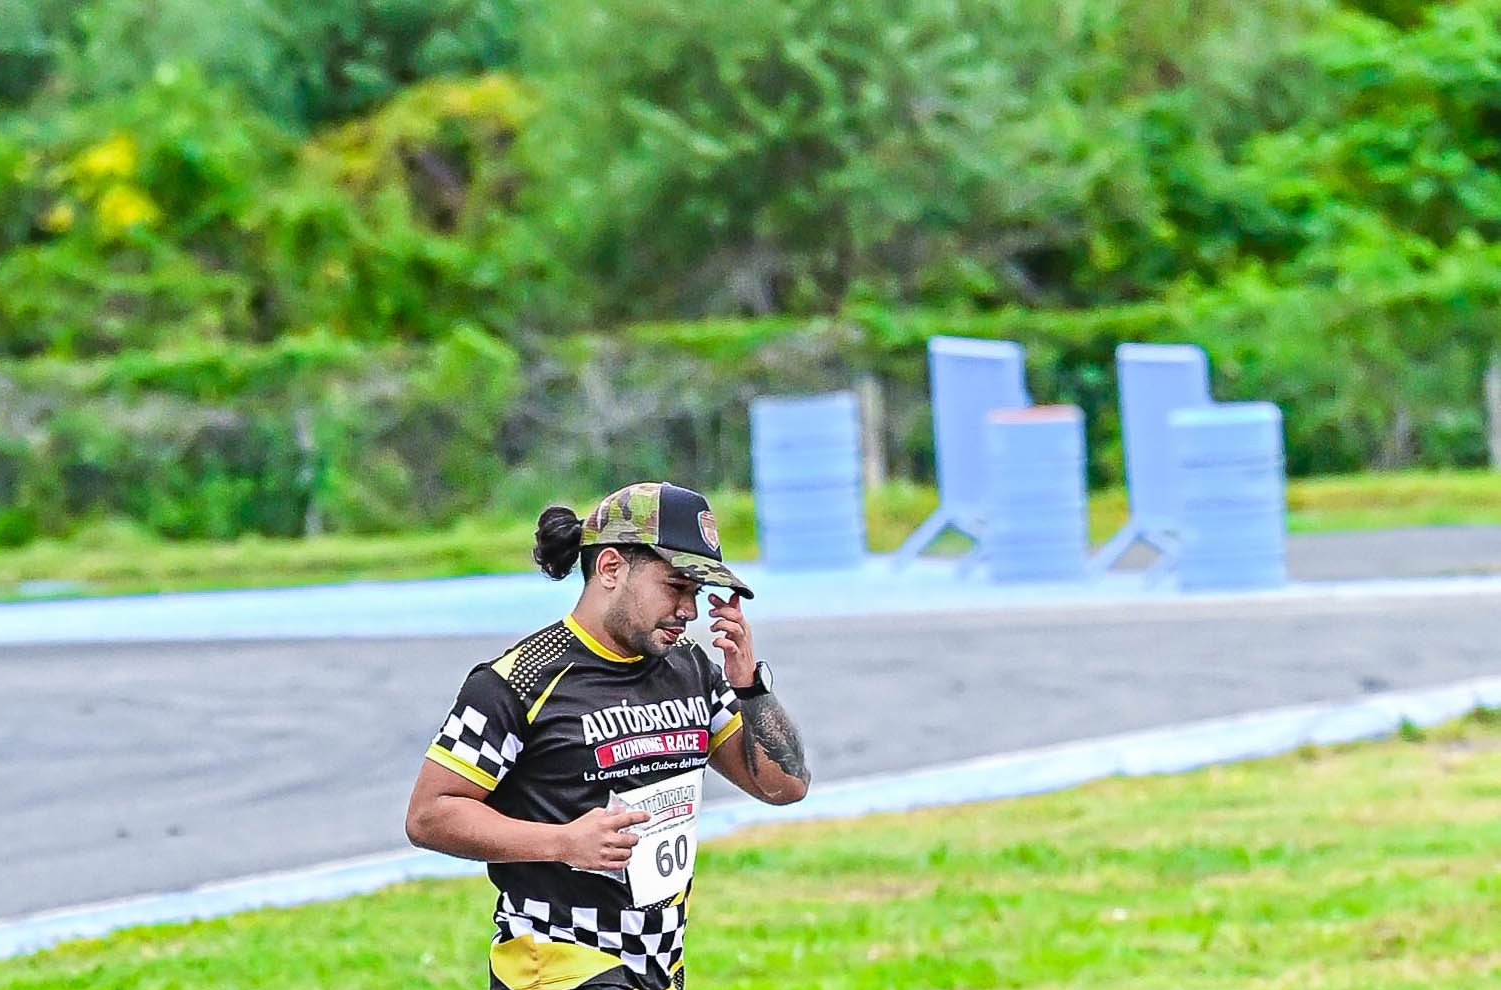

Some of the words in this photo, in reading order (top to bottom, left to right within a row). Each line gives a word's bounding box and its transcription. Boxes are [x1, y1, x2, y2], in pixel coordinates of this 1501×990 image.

[611, 736, 666, 762] RUNNING
[665, 733, 700, 752] RACE
[584, 772, 596, 781] La
[598, 768, 629, 780] Carrera
[630, 765, 640, 774] de
[651, 761, 678, 771] Clubes
[679, 757, 691, 769] del
[655, 834, 688, 878] 60
